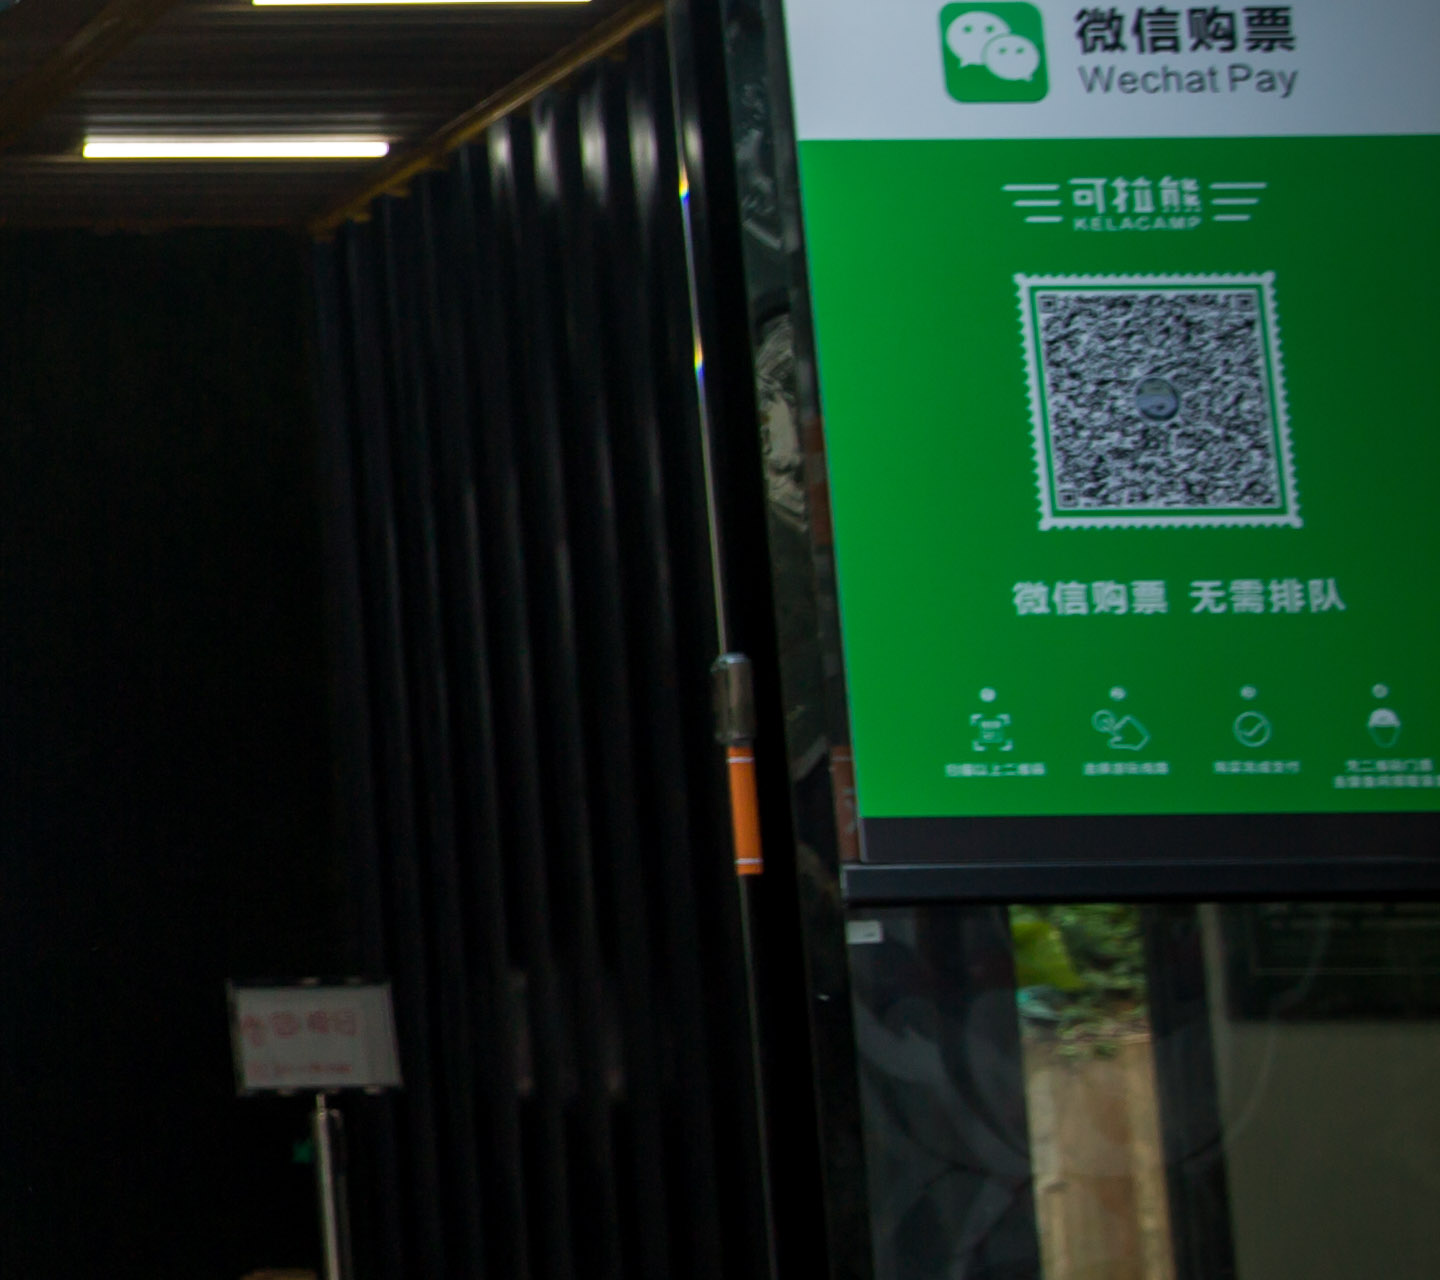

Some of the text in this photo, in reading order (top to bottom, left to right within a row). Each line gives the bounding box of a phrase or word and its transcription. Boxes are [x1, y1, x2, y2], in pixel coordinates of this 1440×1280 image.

[1074, 5, 1298, 55] 微信购票
[1079, 63, 1299, 100] Wechat Pay
[1069, 176, 1202, 214] 可拉熊
[1013, 578, 1346, 617] 微信购票 无需排队
